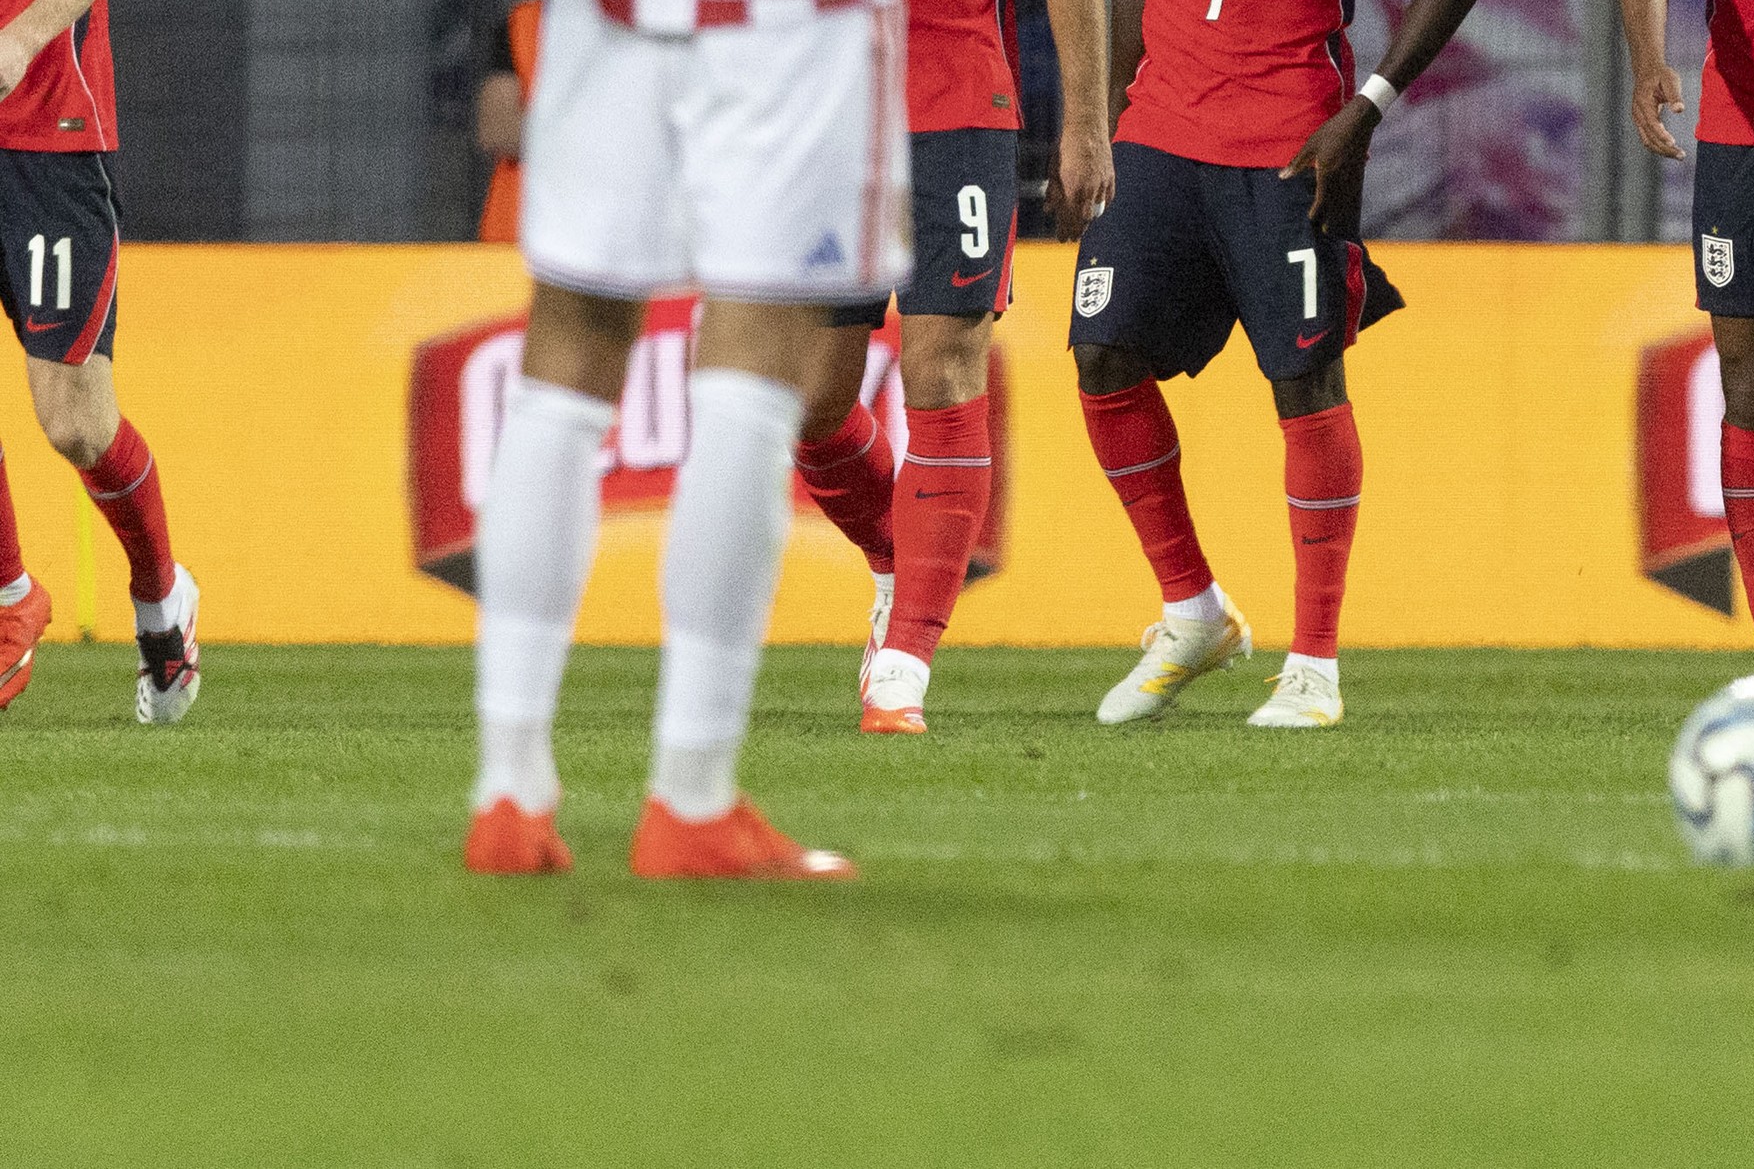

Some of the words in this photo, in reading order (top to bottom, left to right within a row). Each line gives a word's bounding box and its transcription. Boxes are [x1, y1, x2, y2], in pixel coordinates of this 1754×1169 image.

[957, 185, 990, 259] 9
[28, 234, 72, 310] 11
[1287, 248, 1317, 319] 7
